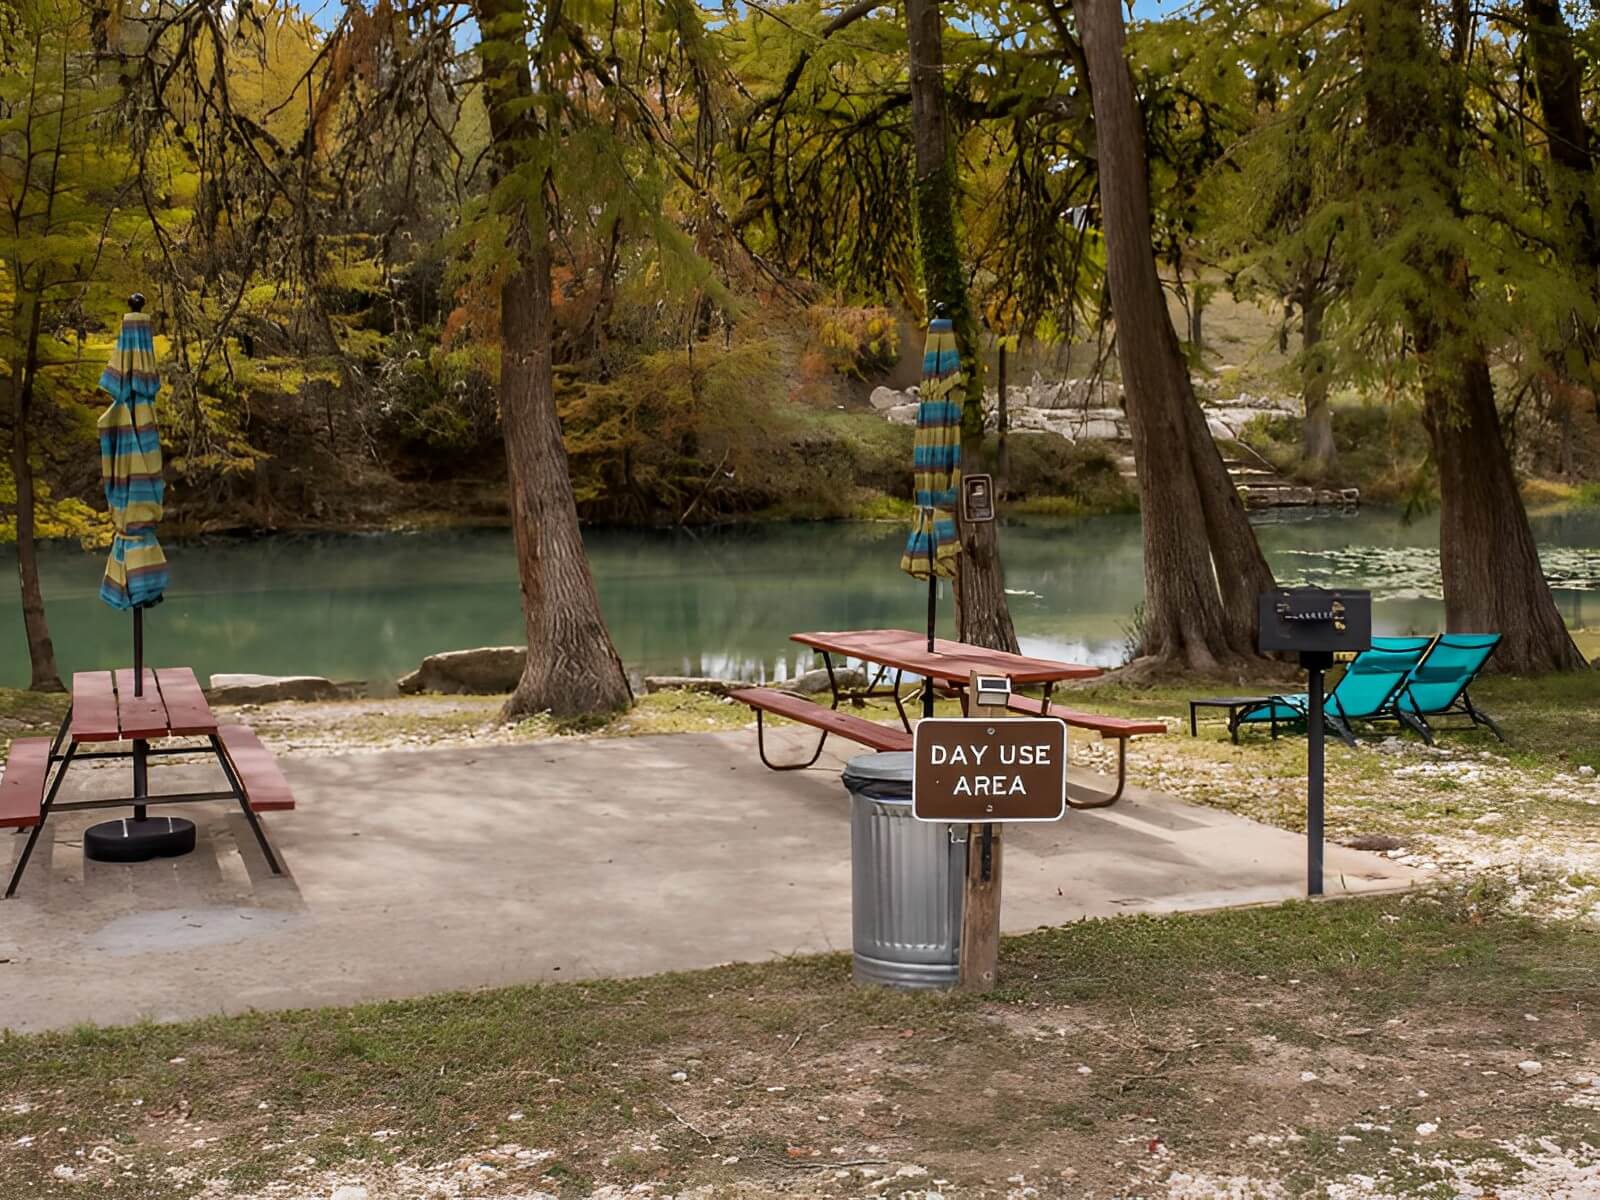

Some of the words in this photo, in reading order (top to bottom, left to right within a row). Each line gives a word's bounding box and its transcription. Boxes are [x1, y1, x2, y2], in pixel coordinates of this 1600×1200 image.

[930, 744, 989, 766] DAY
[999, 744, 1051, 766] USE
[953, 775, 1027, 796] AREA
